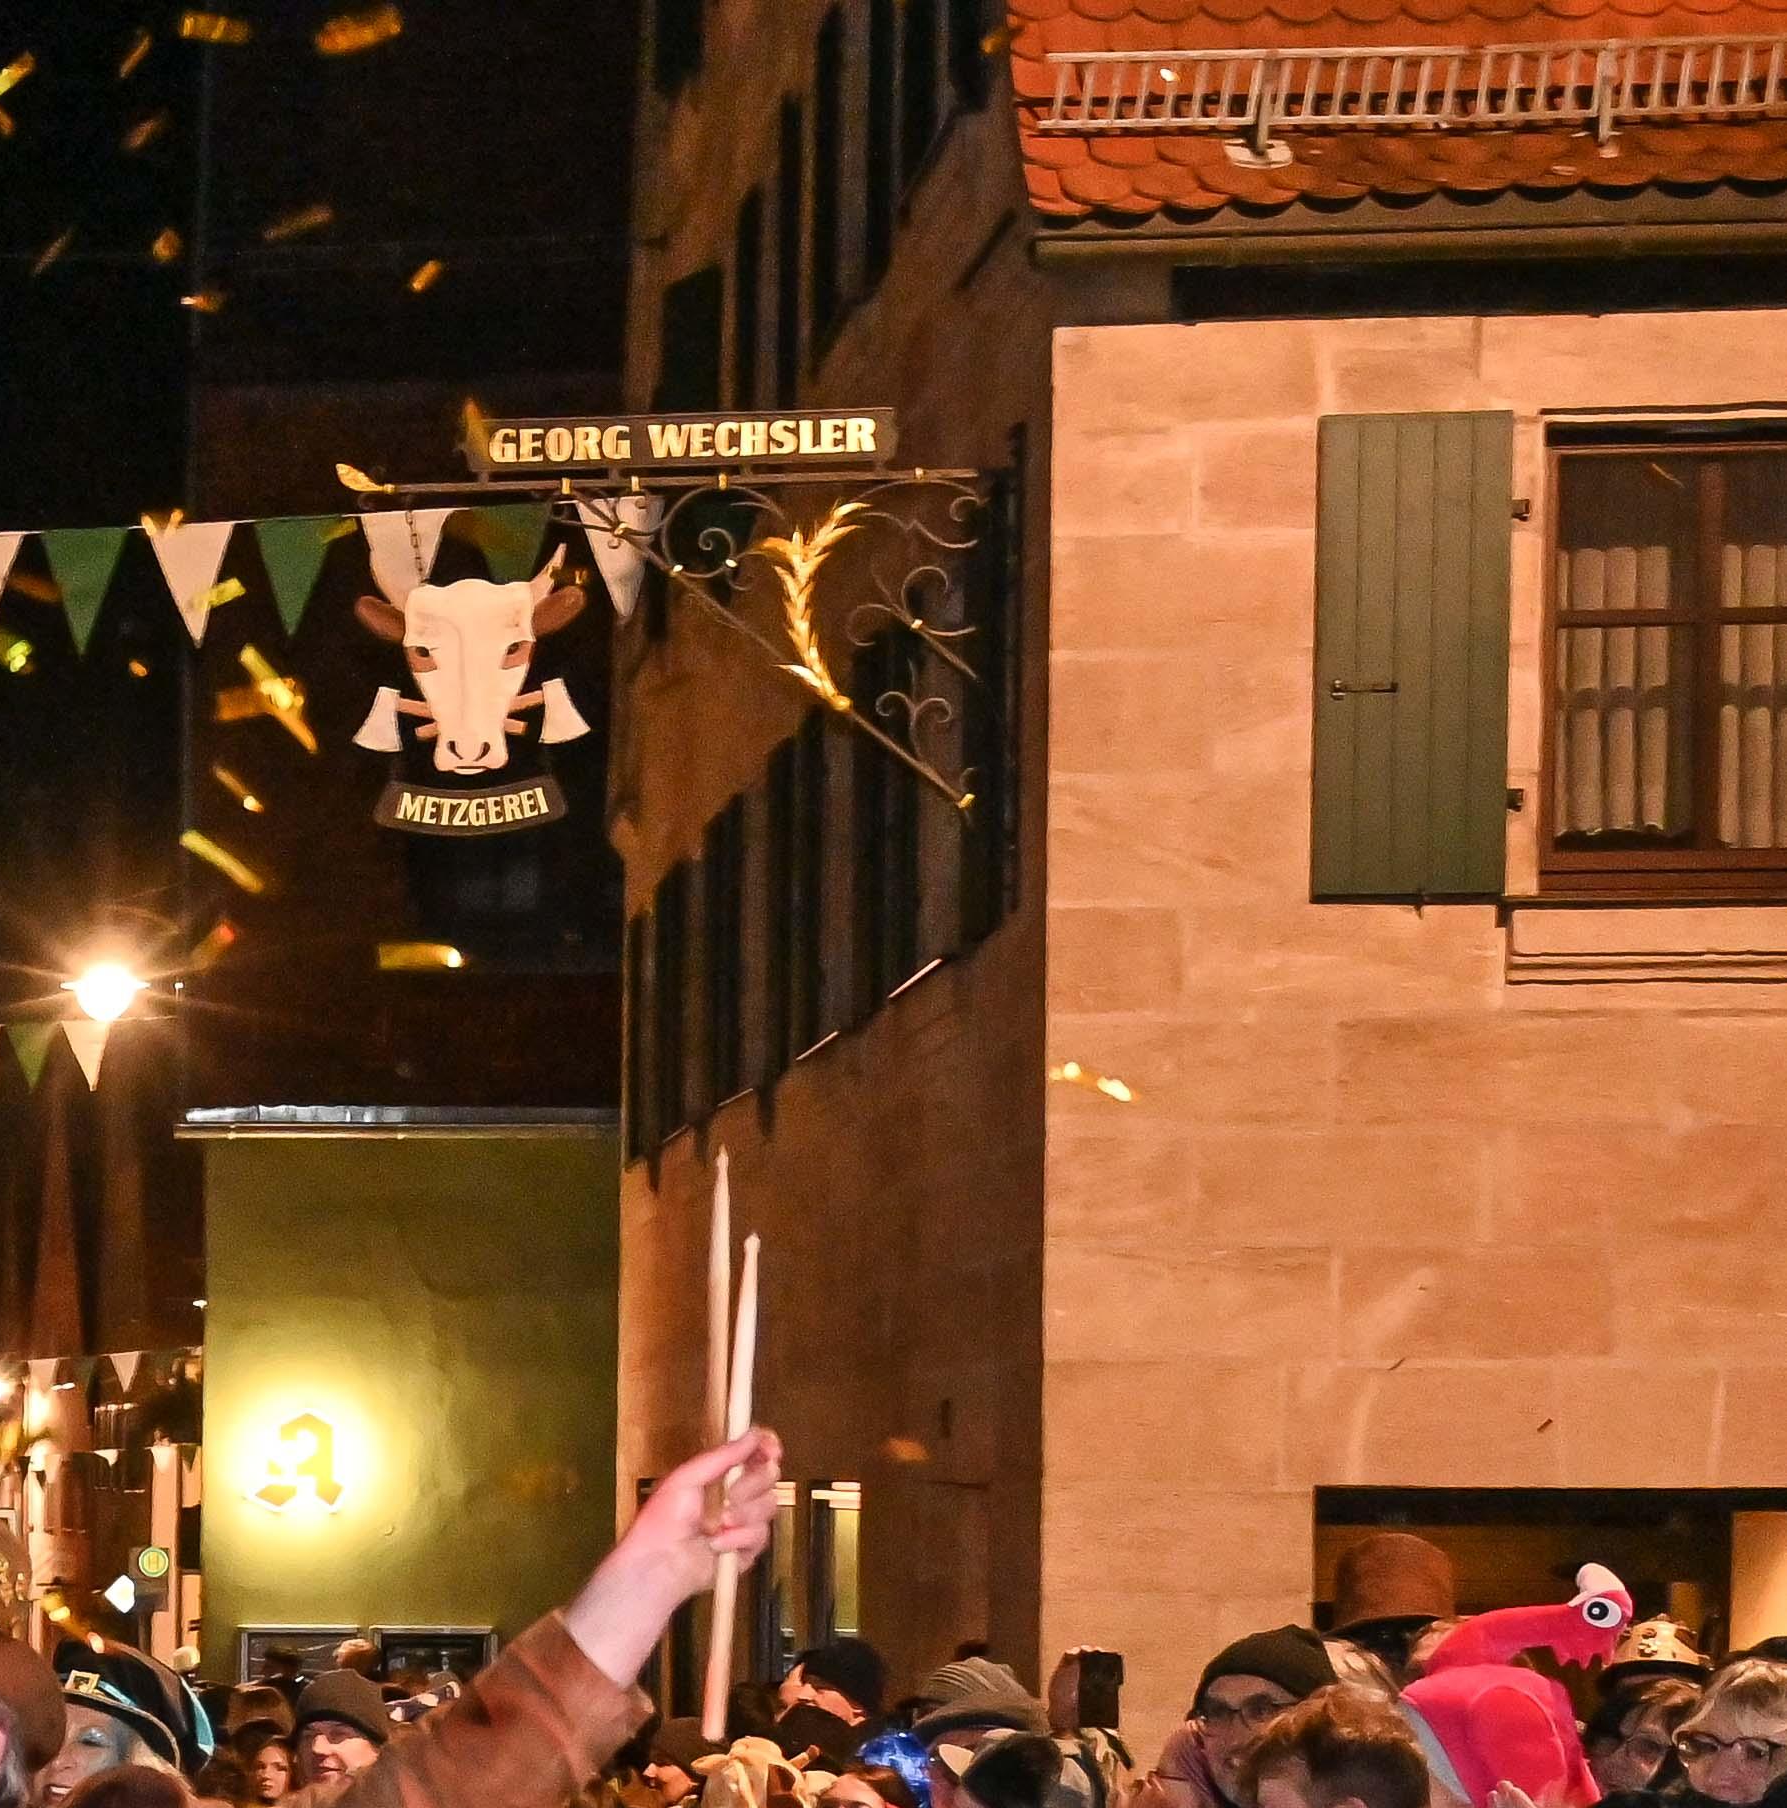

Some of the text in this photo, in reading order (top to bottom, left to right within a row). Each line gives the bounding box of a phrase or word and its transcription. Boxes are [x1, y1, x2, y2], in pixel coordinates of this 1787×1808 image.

[488, 417, 877, 464] GEORG WECHSLER
[395, 786, 550, 827] METZGEREI
